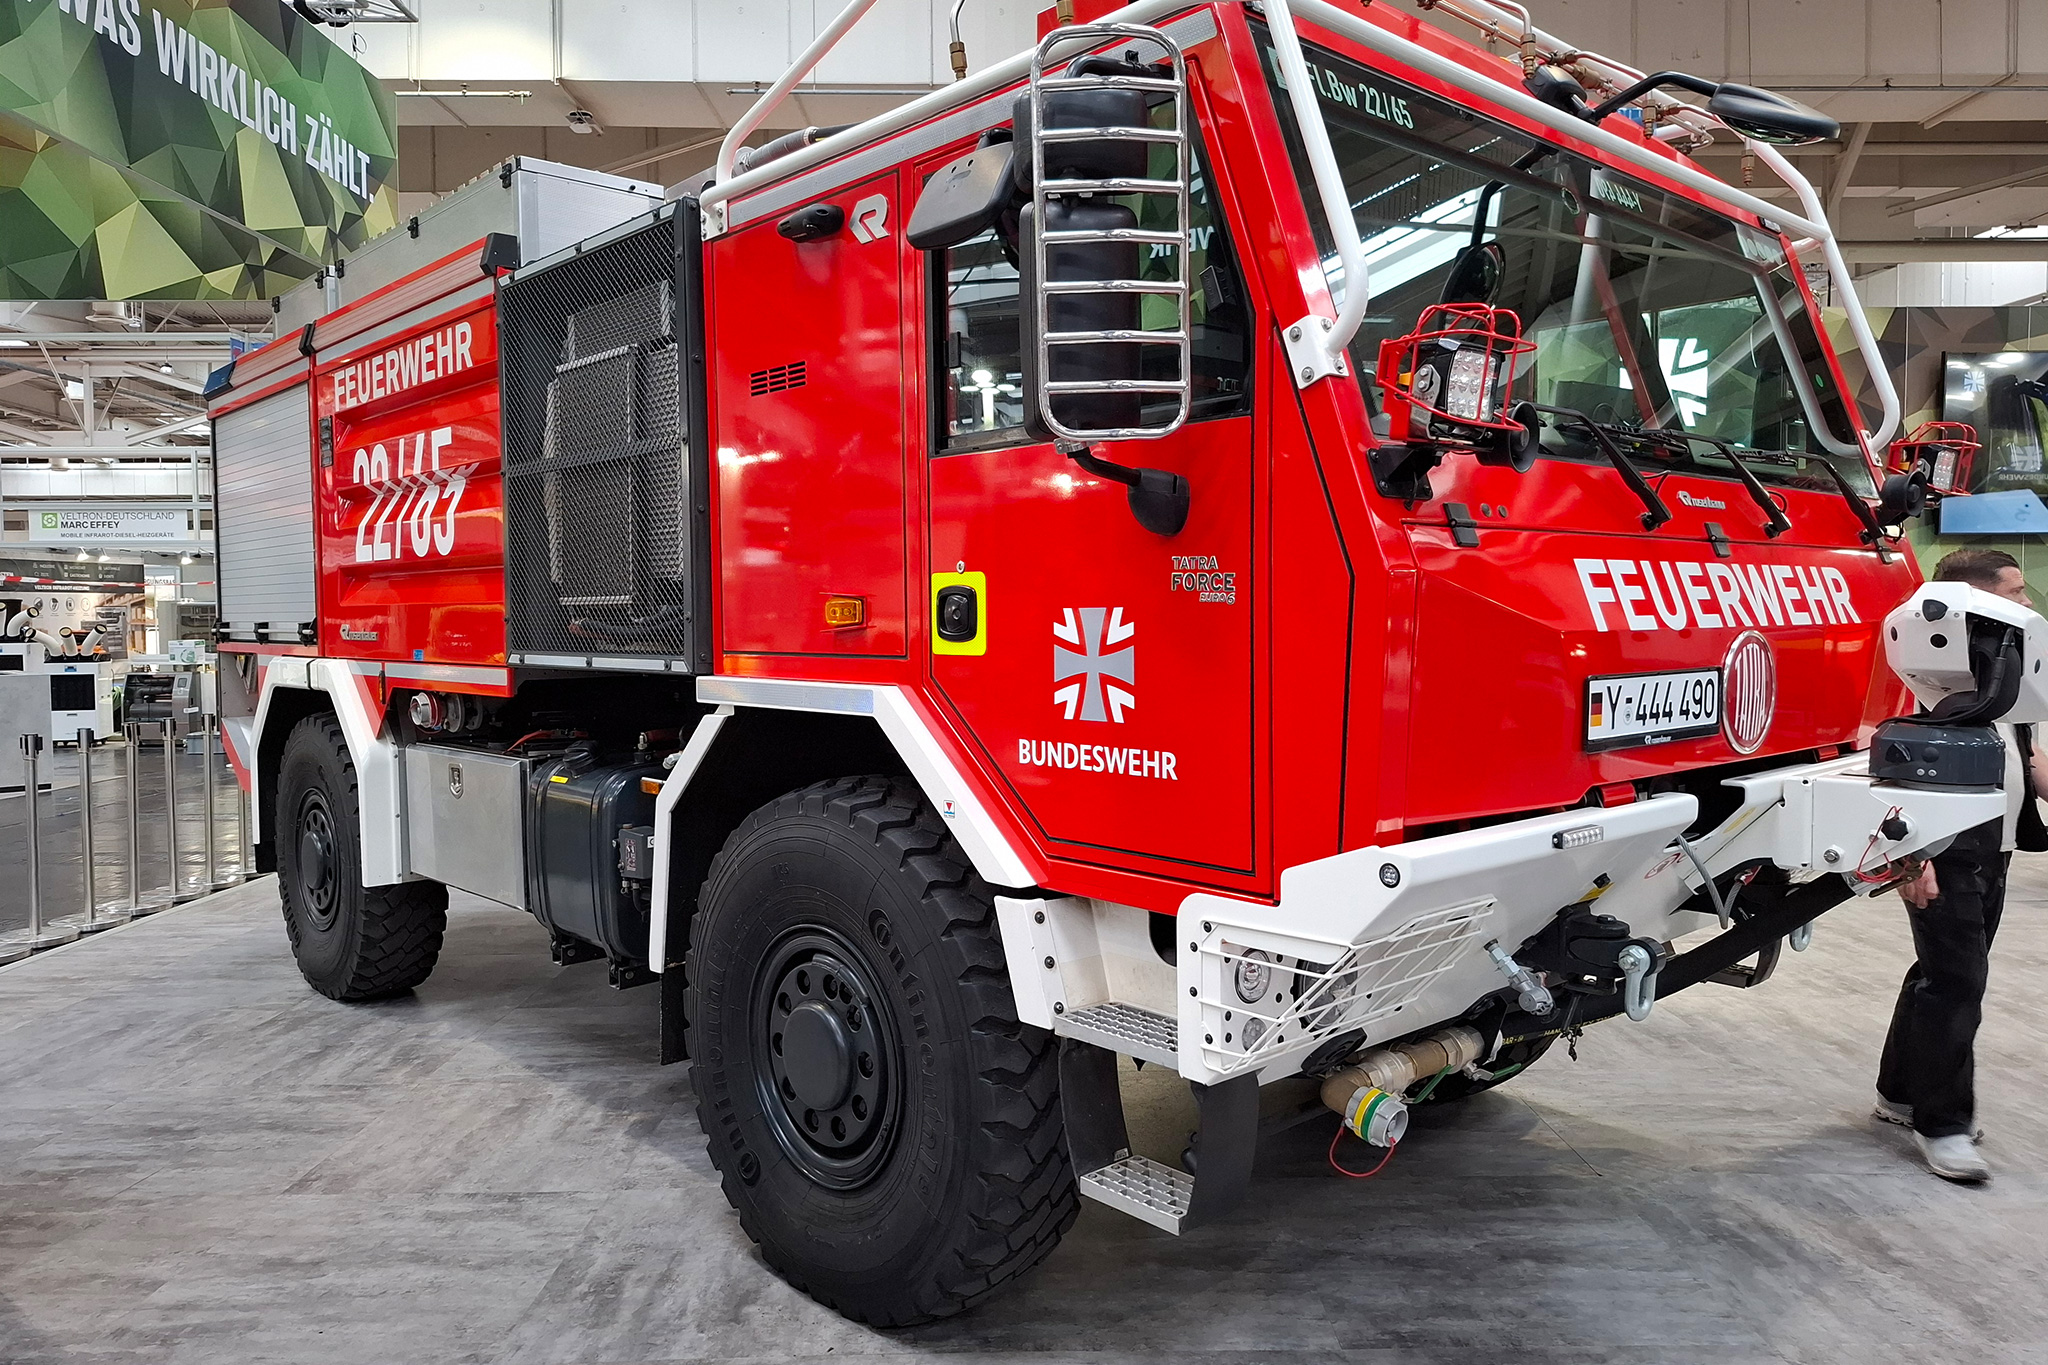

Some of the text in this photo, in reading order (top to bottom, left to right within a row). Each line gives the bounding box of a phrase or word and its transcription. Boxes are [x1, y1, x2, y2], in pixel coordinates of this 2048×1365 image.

[59, 0, 374, 203] AS WIRKLICH ZÄHLT.
[1359, 83, 1414, 129] 22/65
[334, 321, 473, 412] FEUERWEHR
[60, 511, 175, 520] VELTRON-DEUTSCHLAND
[353, 426, 466, 562] 22/65
[60, 521, 120, 529] MARC EFFEY
[1170, 572, 1236, 592] FORCE
[1171, 555, 1219, 570] TATRA
[1573, 558, 1862, 632] FEUERWEHR
[1679, 678, 1715, 721] 490
[1734, 643, 1767, 741] TATRA
[1018, 738, 1178, 780] BUNDESWEHR
